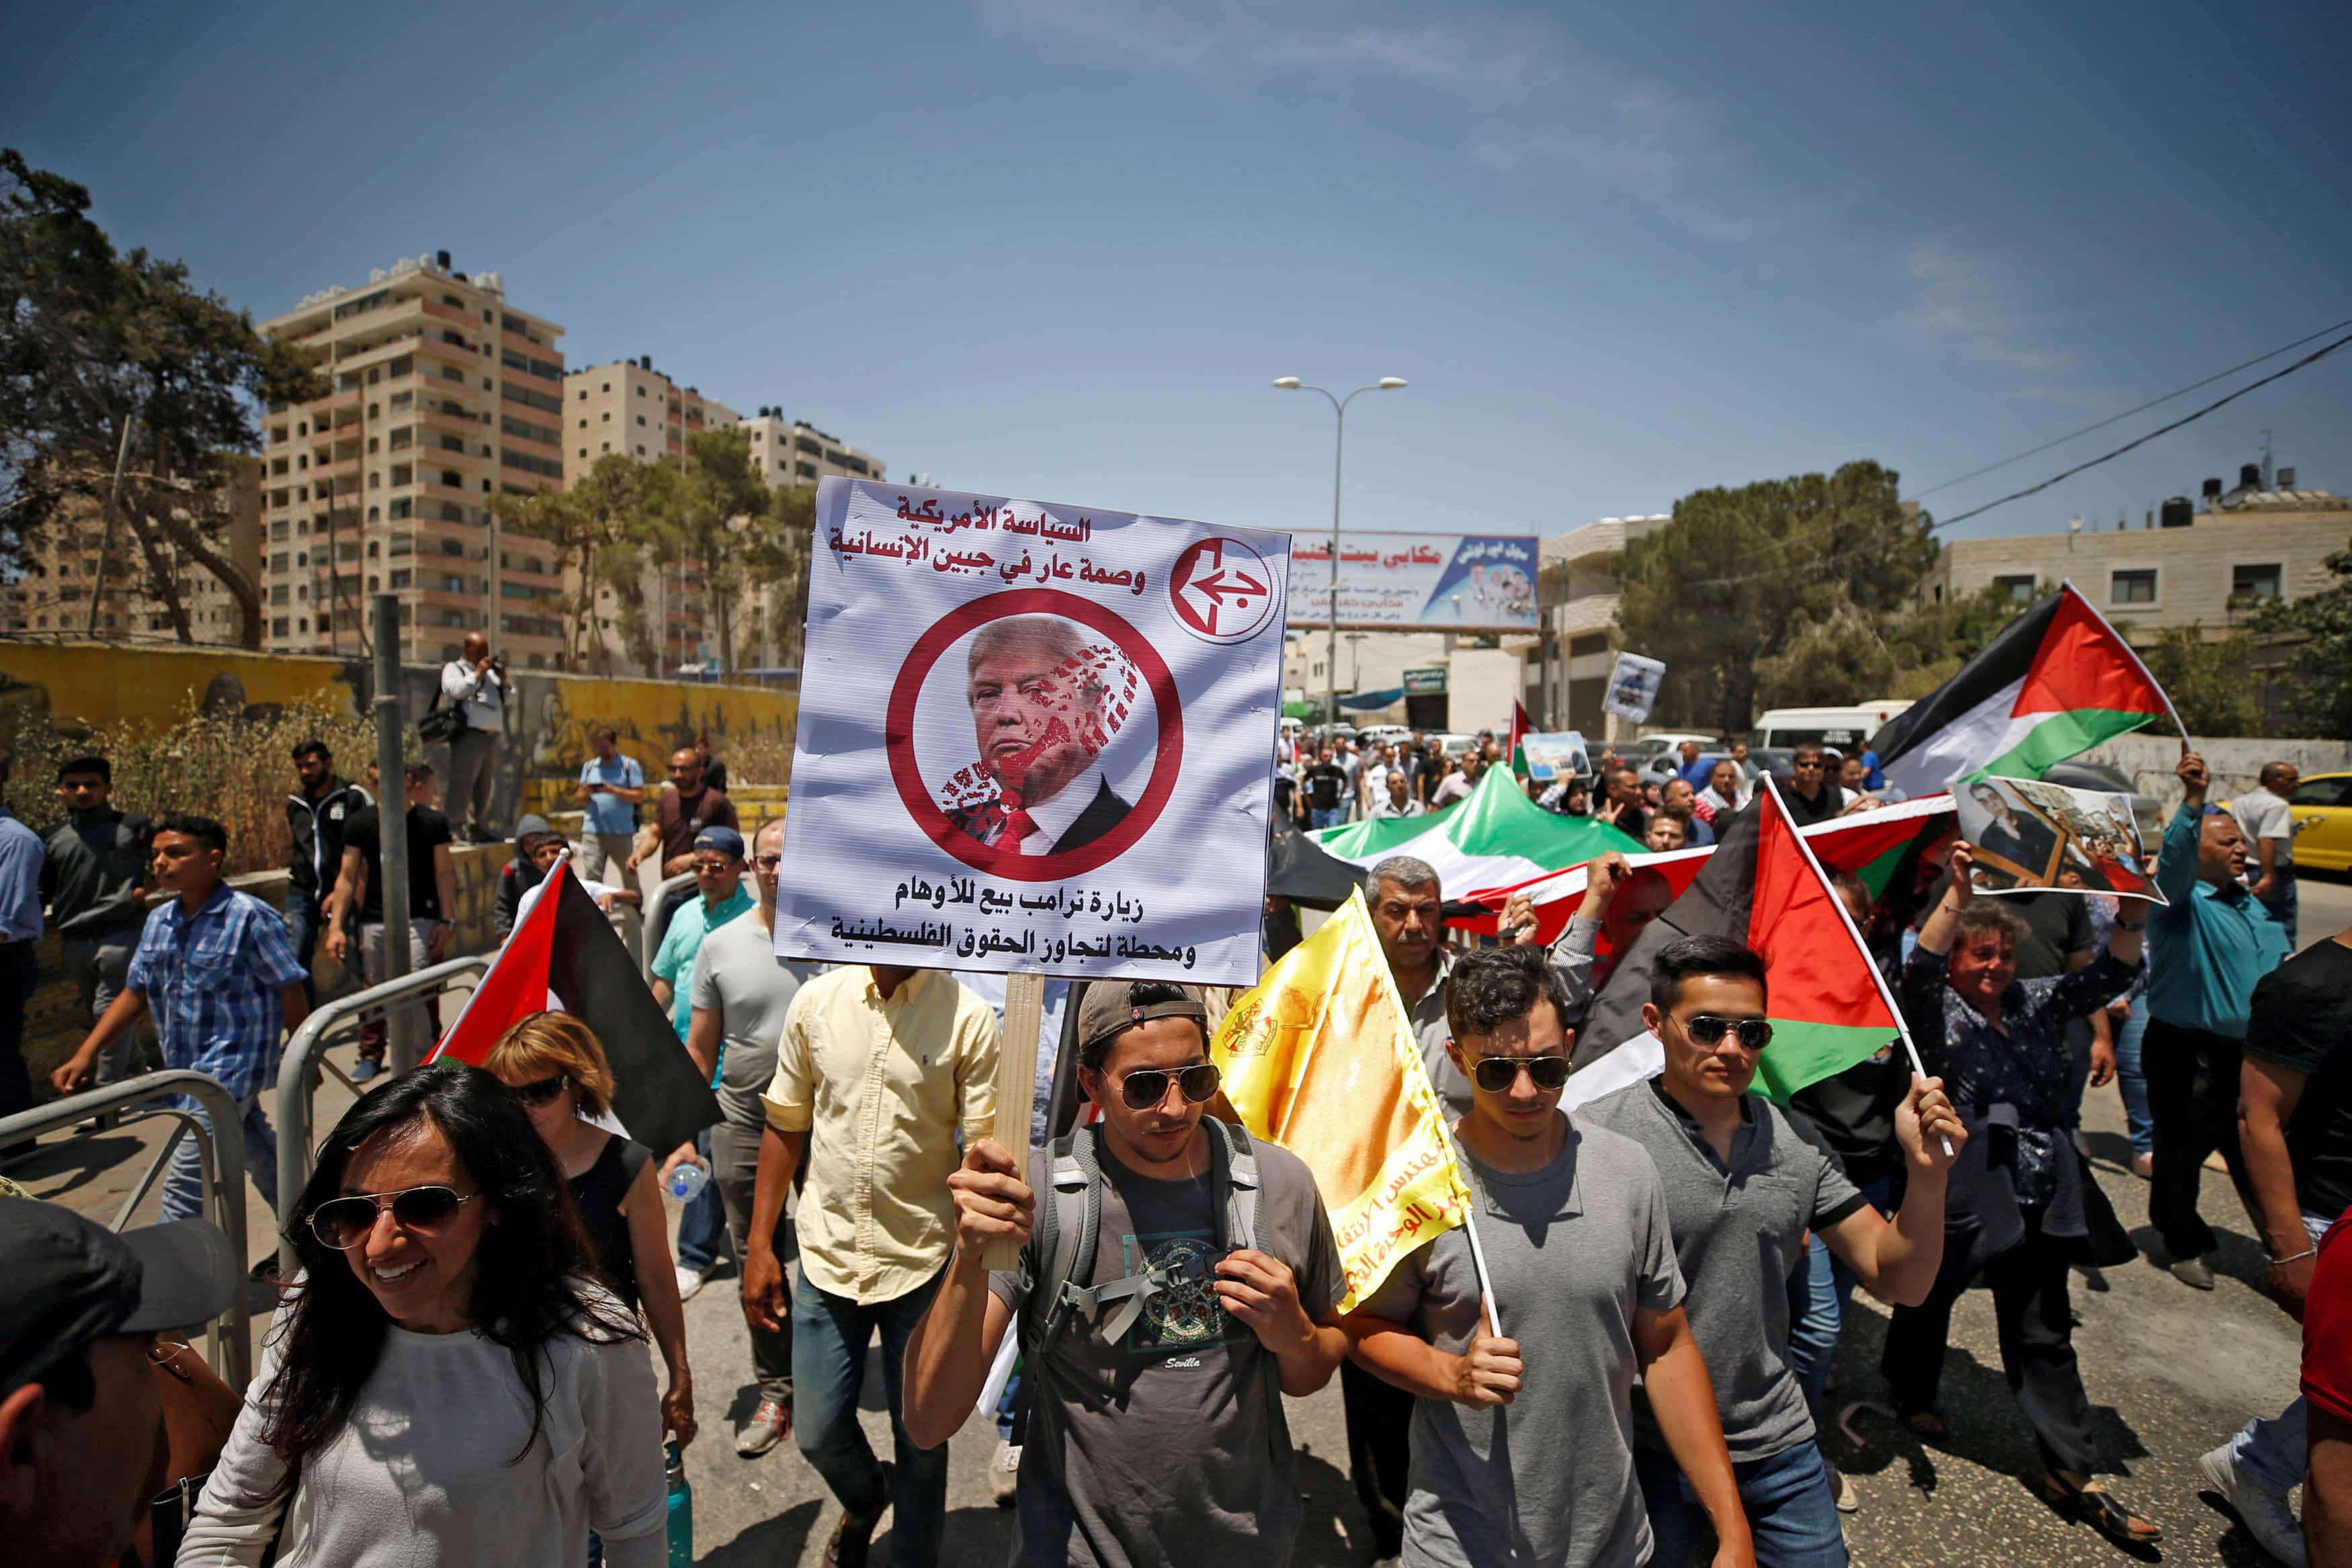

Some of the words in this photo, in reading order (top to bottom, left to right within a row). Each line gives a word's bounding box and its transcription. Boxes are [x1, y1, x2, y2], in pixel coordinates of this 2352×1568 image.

[897, 496, 998, 533] الأمريكية
[1002, 509, 1091, 545] السياسة
[829, 527, 929, 566] الإنسانية
[933, 546, 995, 574] جبين
[1292, 542, 1334, 566] حنين
[999, 548, 1032, 585] في
[1036, 553, 1074, 584] عار
[1079, 556, 1146, 595] وصمة
[895, 875, 975, 911] للأوهام
[979, 885, 1013, 915] بيع
[1019, 887, 1084, 918] ترامب
[1090, 891, 1144, 923] زيارة
[831, 914, 952, 949] الفلسطينية
[956, 928, 1035, 959] الحقوق
[1040, 932, 1111, 965] لتجاوز
[1116, 935, 1196, 969] ومحطة
[1165, 1356, 1201, 1369] Sevilla
